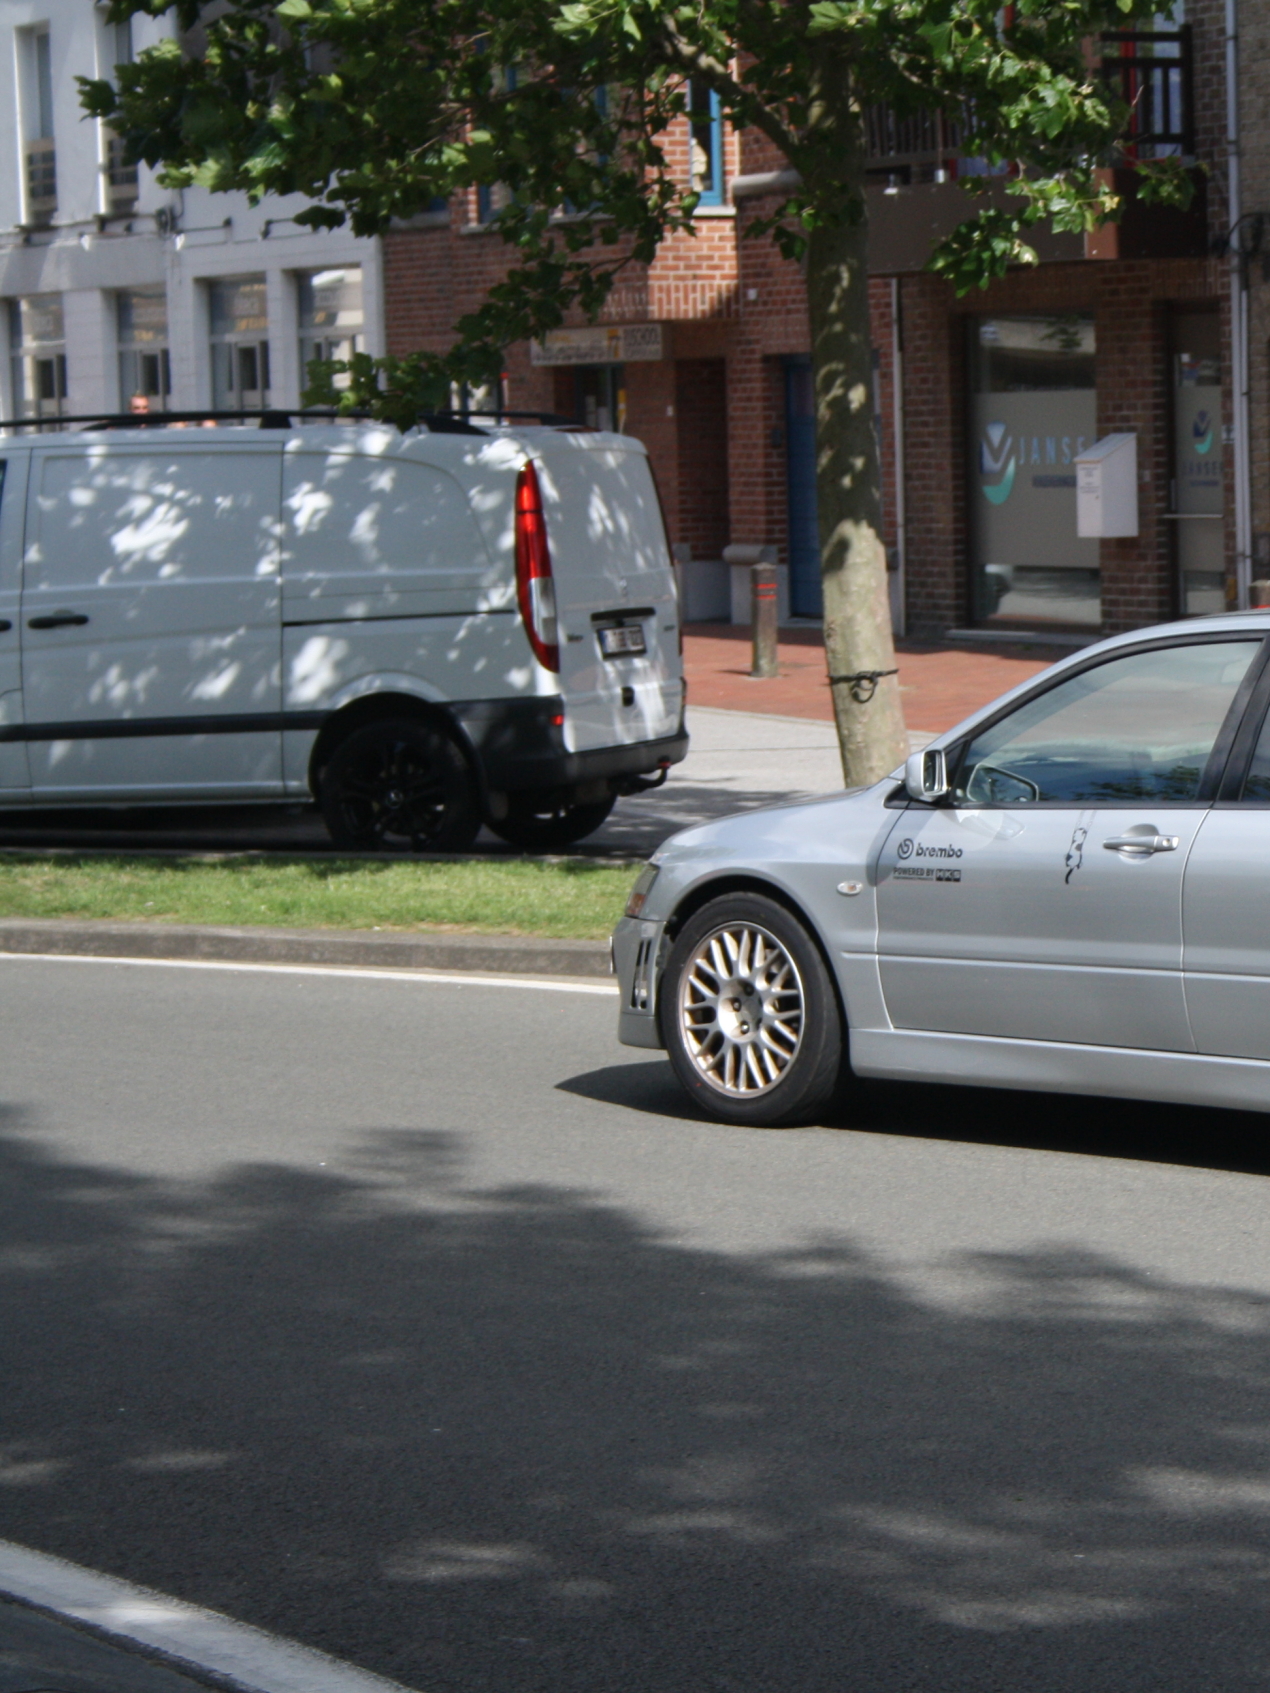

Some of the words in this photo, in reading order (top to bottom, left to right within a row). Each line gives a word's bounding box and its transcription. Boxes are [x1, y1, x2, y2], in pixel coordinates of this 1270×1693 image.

[915, 842, 963, 858] brembo
[893, 867, 924, 876] POWERED
[926, 868, 935, 876] BY
[935, 869, 962, 882] HKS
